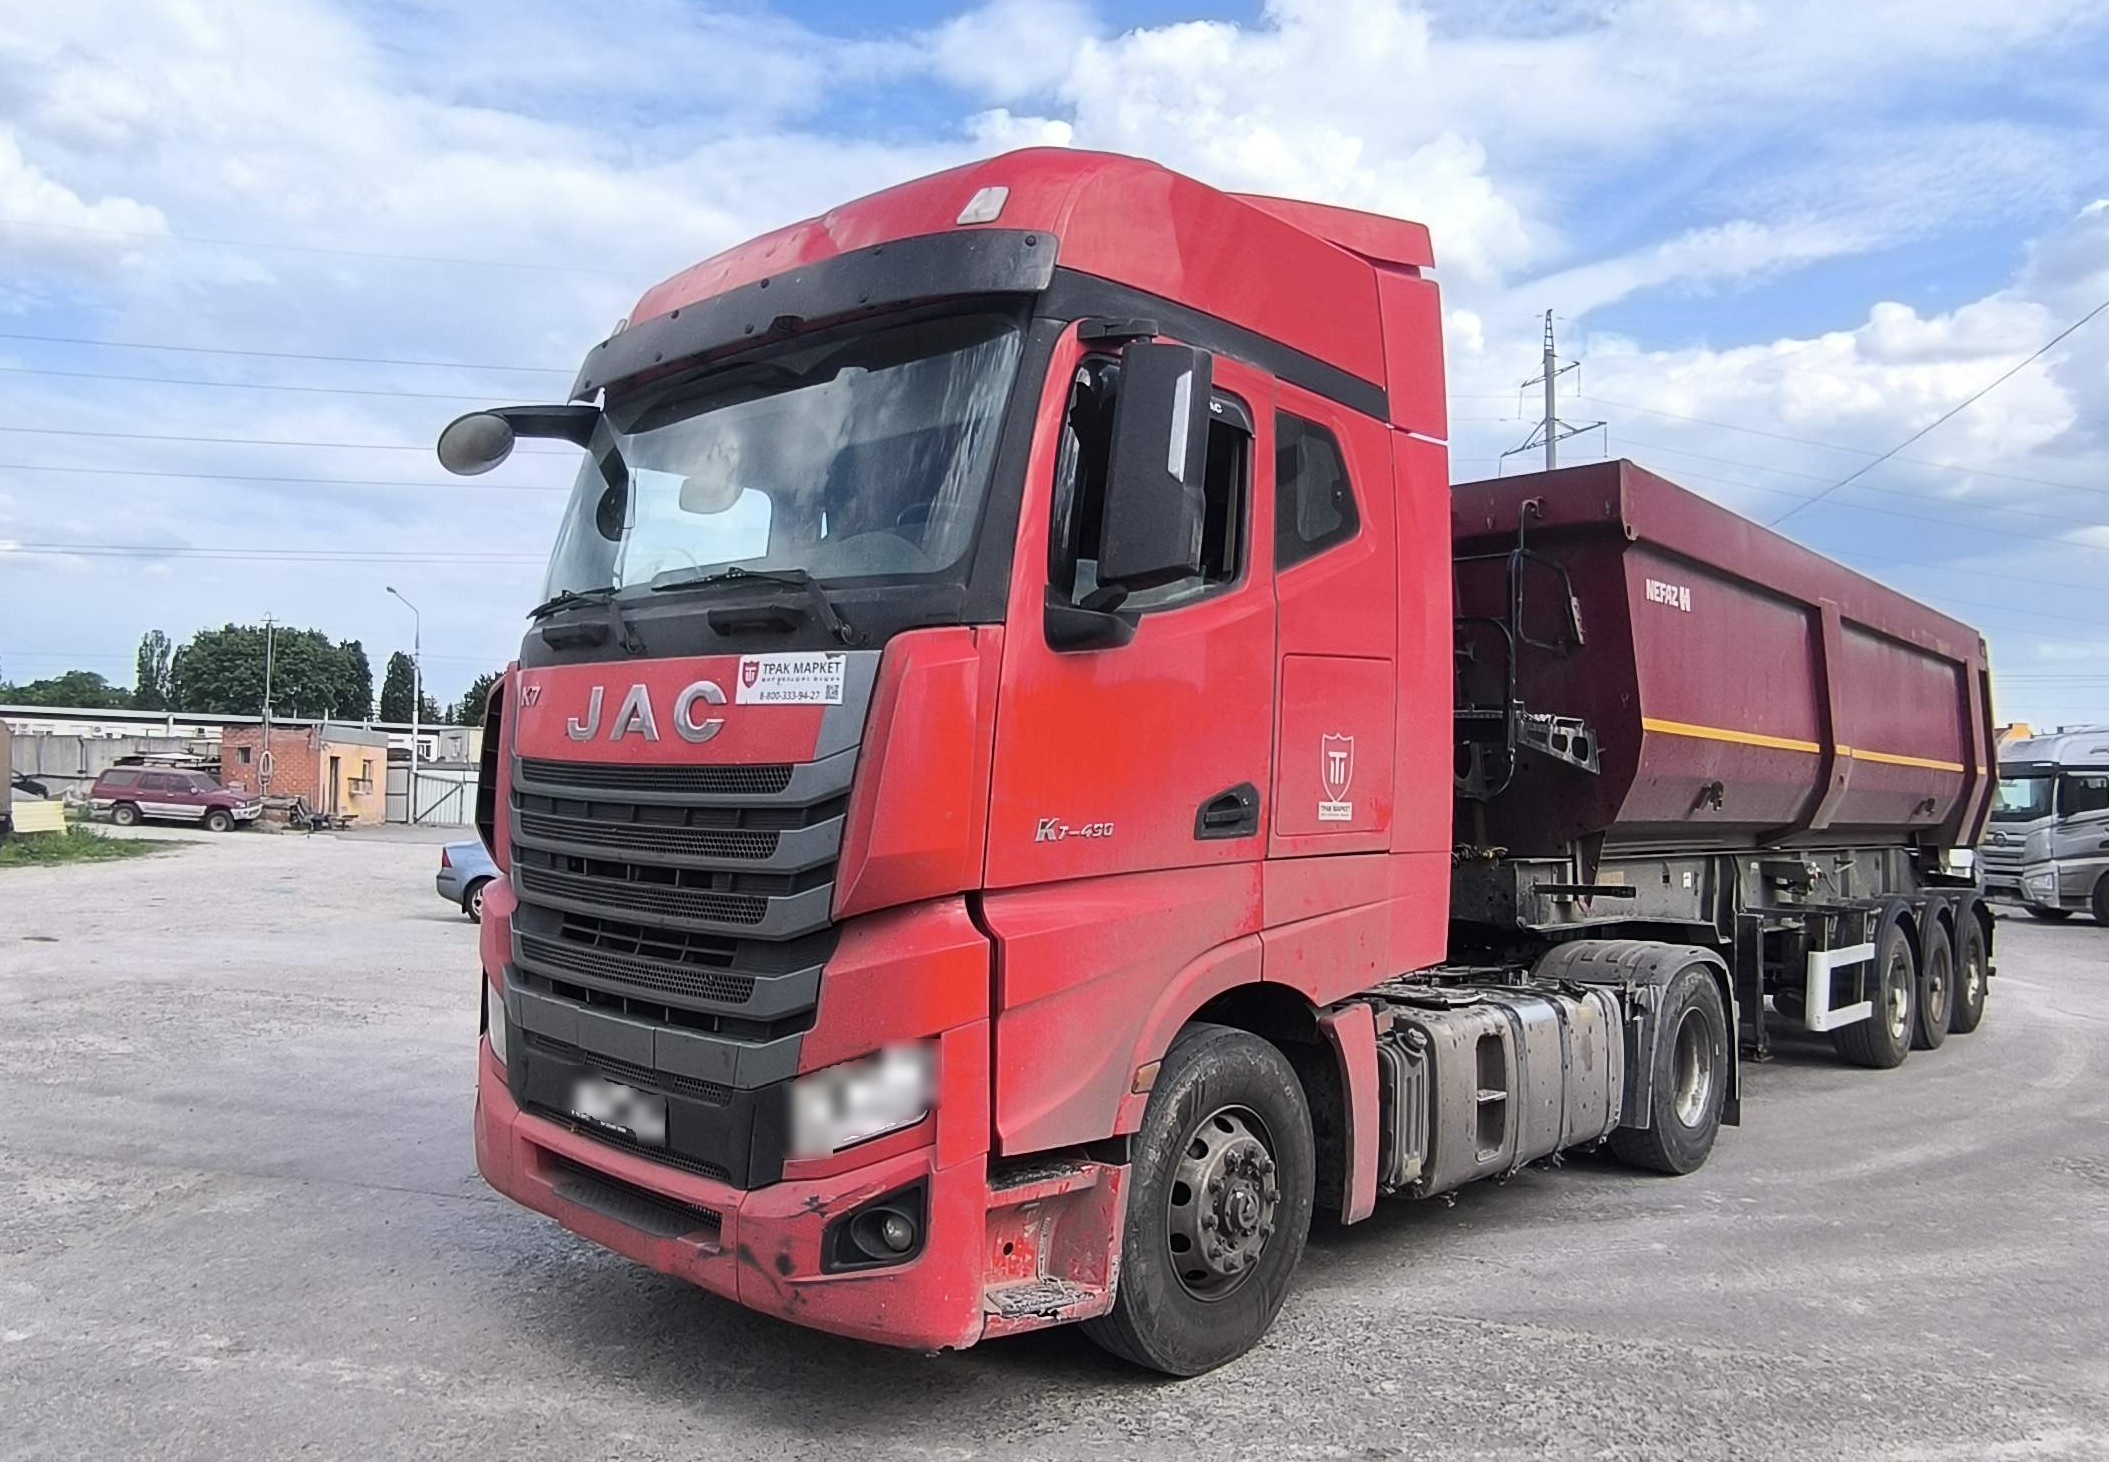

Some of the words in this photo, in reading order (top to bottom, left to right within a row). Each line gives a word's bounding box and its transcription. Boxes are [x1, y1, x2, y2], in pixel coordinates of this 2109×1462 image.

[1645, 578, 1679, 607] NEFAZ
[762, 662, 791, 675] ТРАК
[793, 661, 842, 674] МАРКЕТ
[521, 685, 541, 706] K7
[567, 680, 727, 743] JAC
